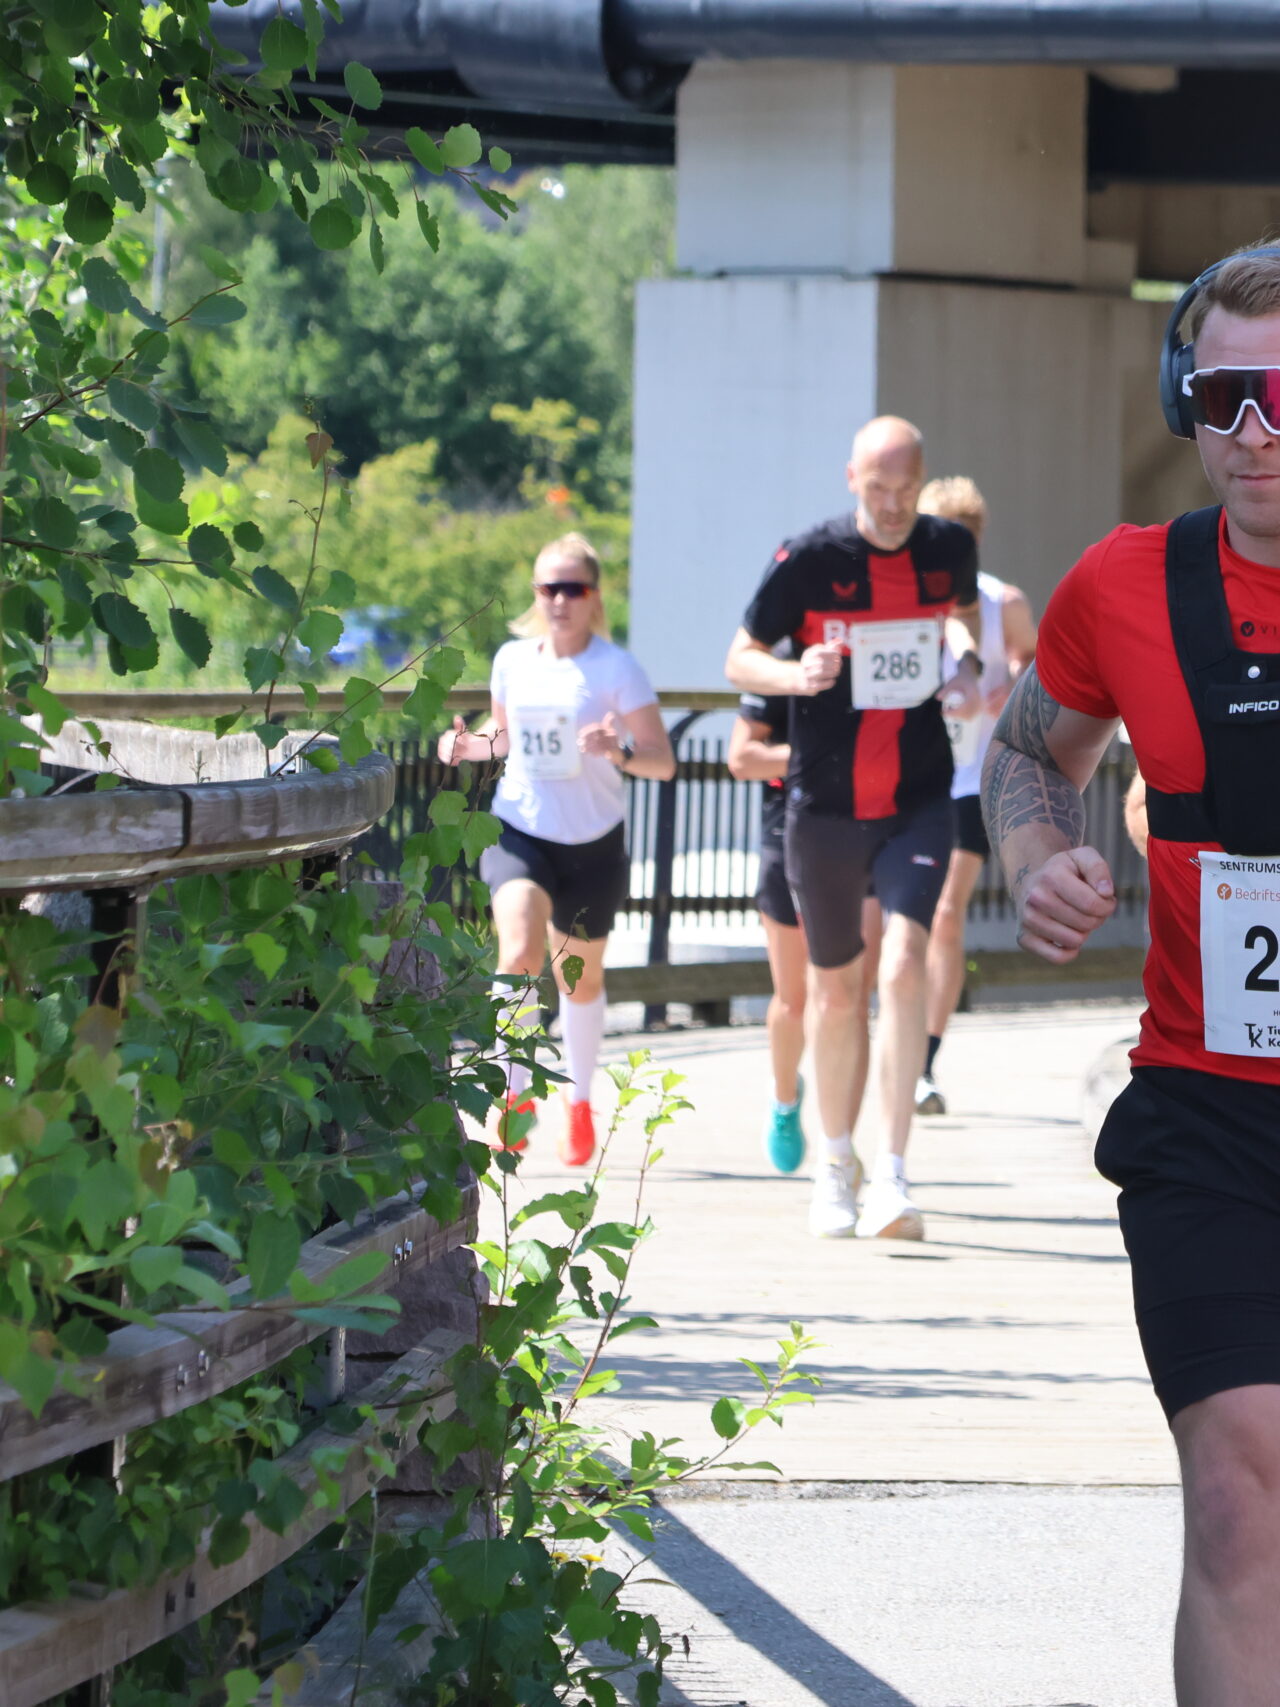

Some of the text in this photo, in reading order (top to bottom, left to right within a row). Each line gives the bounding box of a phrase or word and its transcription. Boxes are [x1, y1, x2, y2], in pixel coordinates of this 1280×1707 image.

[872, 650, 922, 681] 286
[1228, 700, 1280, 715] INFICO
[522, 727, 562, 756] 215
